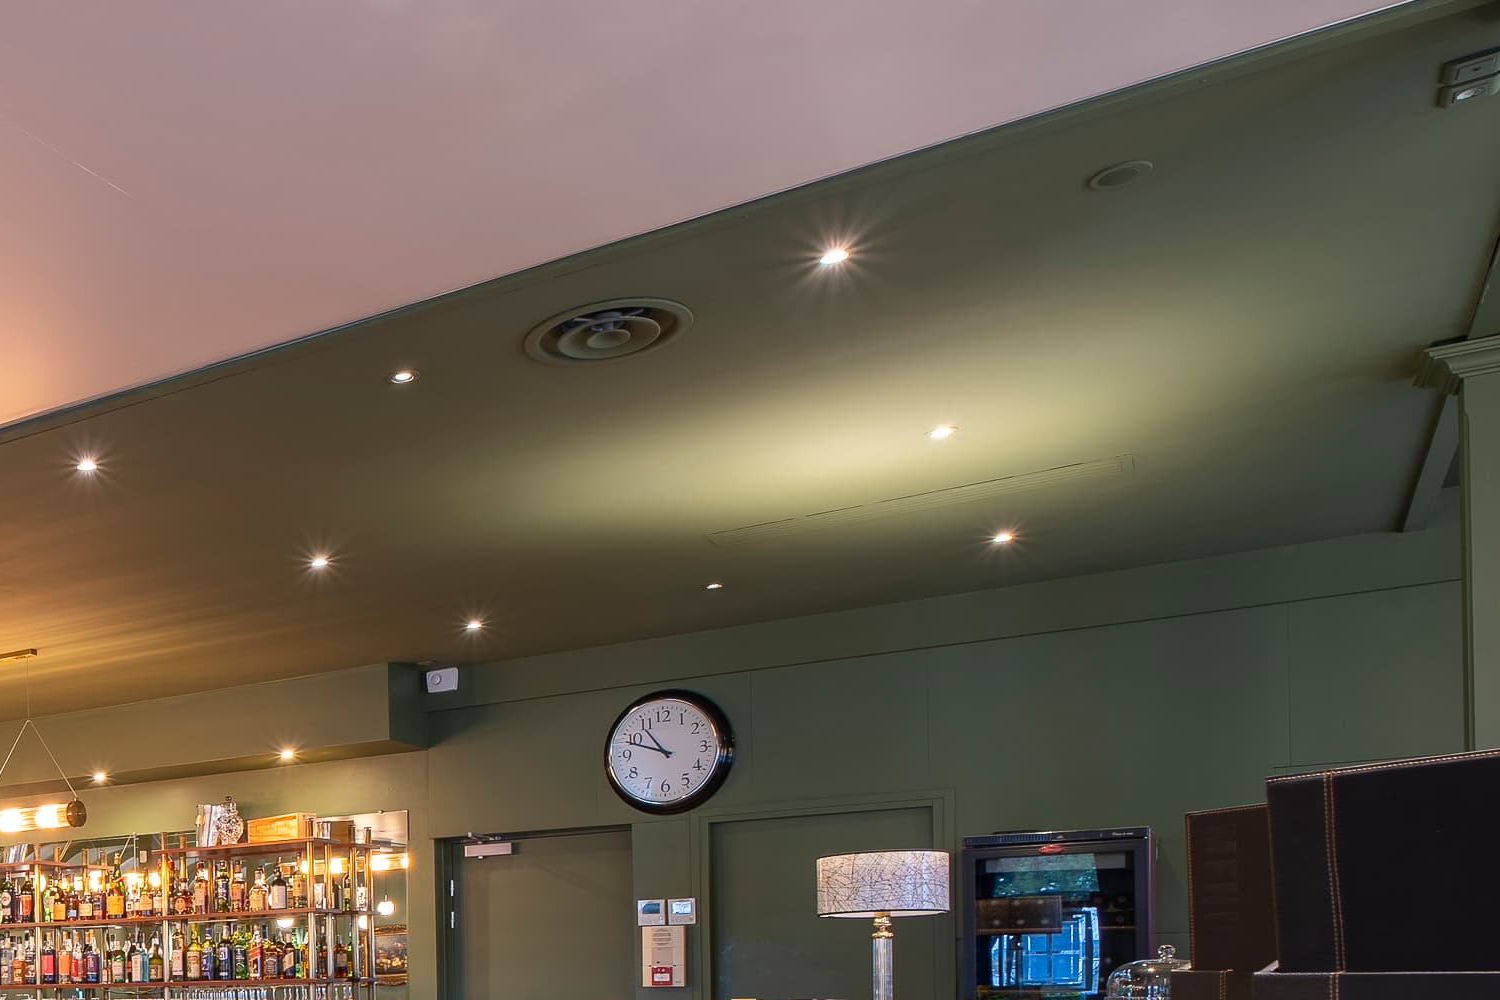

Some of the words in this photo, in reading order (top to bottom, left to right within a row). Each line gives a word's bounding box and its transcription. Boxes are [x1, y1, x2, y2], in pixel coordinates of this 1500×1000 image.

[655, 709, 671, 723] 12
[680, 713, 685, 725] 1
[641, 717, 653, 730] 11
[690, 722, 700, 735] 2
[628, 732, 643, 745] 10
[699, 739, 708, 753] 3
[622, 749, 632, 762] 9
[692, 758, 703, 771] 4
[628, 766, 639, 779] 8
[644, 776, 653, 789] 7
[660, 779, 671, 793] 6
[681, 773, 690, 787] 5
